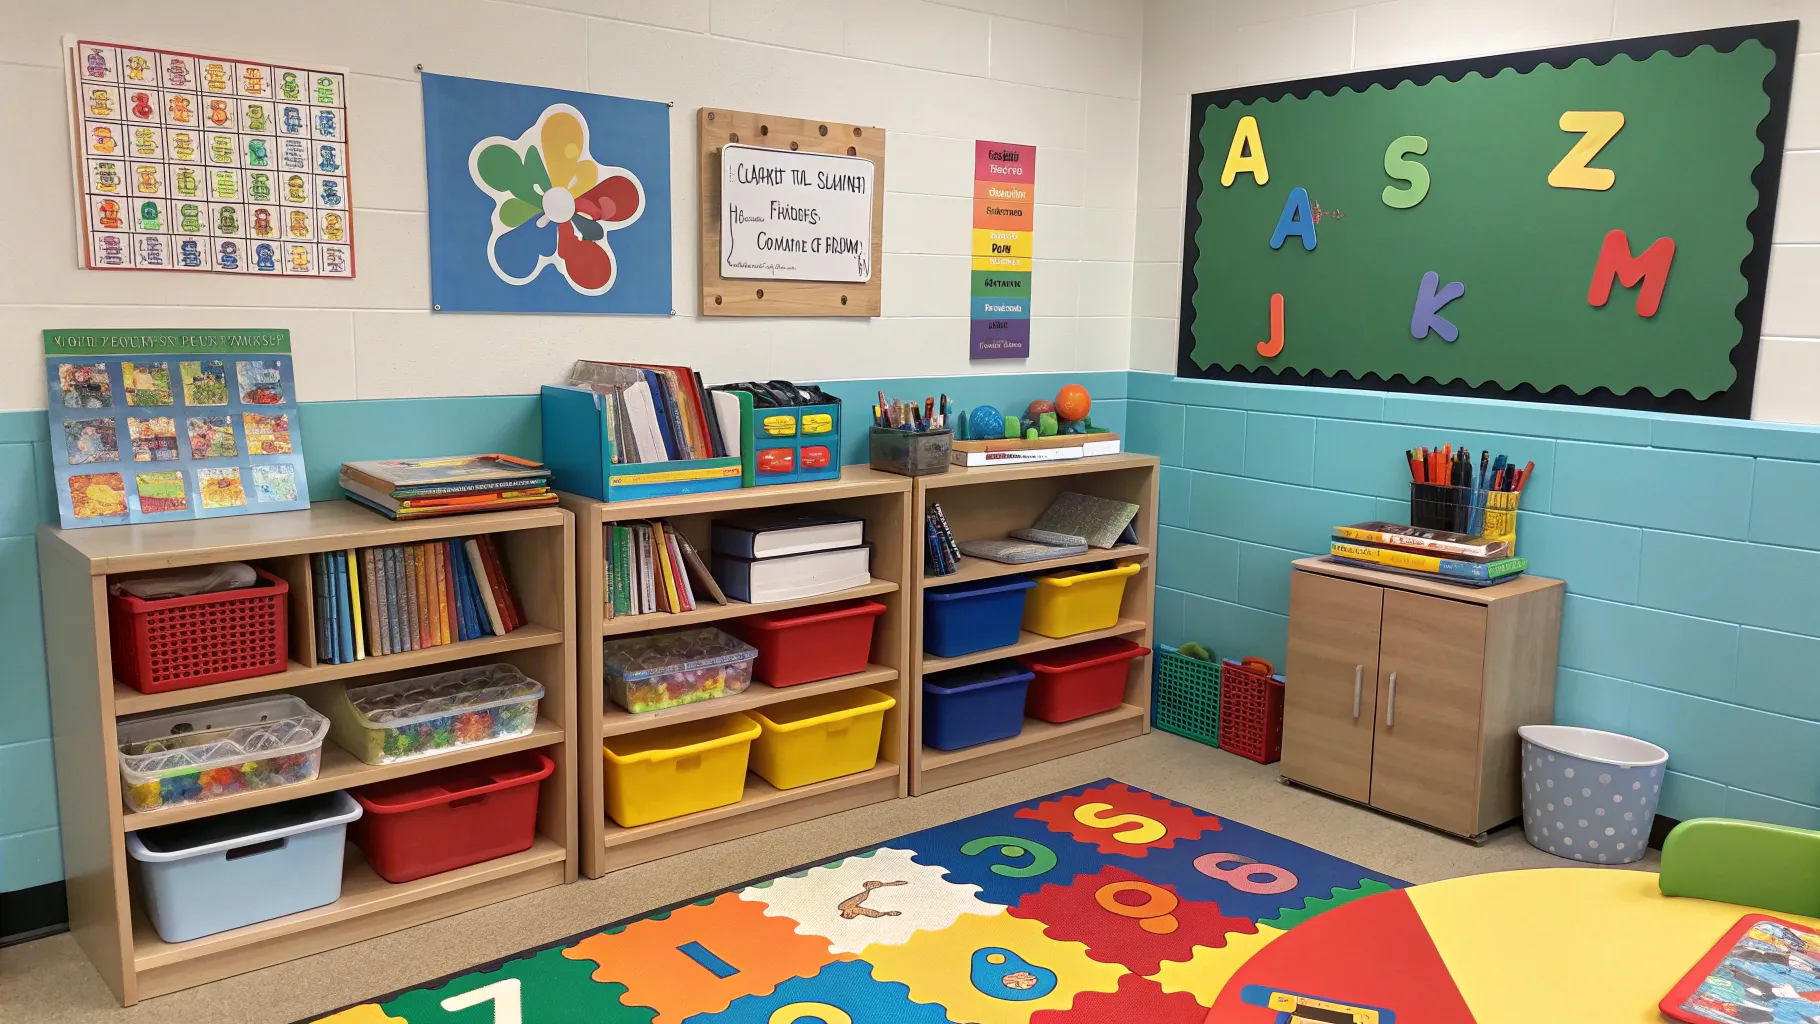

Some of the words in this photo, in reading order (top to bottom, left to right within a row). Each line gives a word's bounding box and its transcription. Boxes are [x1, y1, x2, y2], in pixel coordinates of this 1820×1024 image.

[1220, 116, 1269, 187] A
[1382, 135, 1430, 209] S
[1547, 110, 1625, 191] Z
[1269, 187, 1317, 251] A
[1410, 271, 1465, 342] K
[1587, 229, 1675, 317] M
[1256, 293, 1284, 358] J
